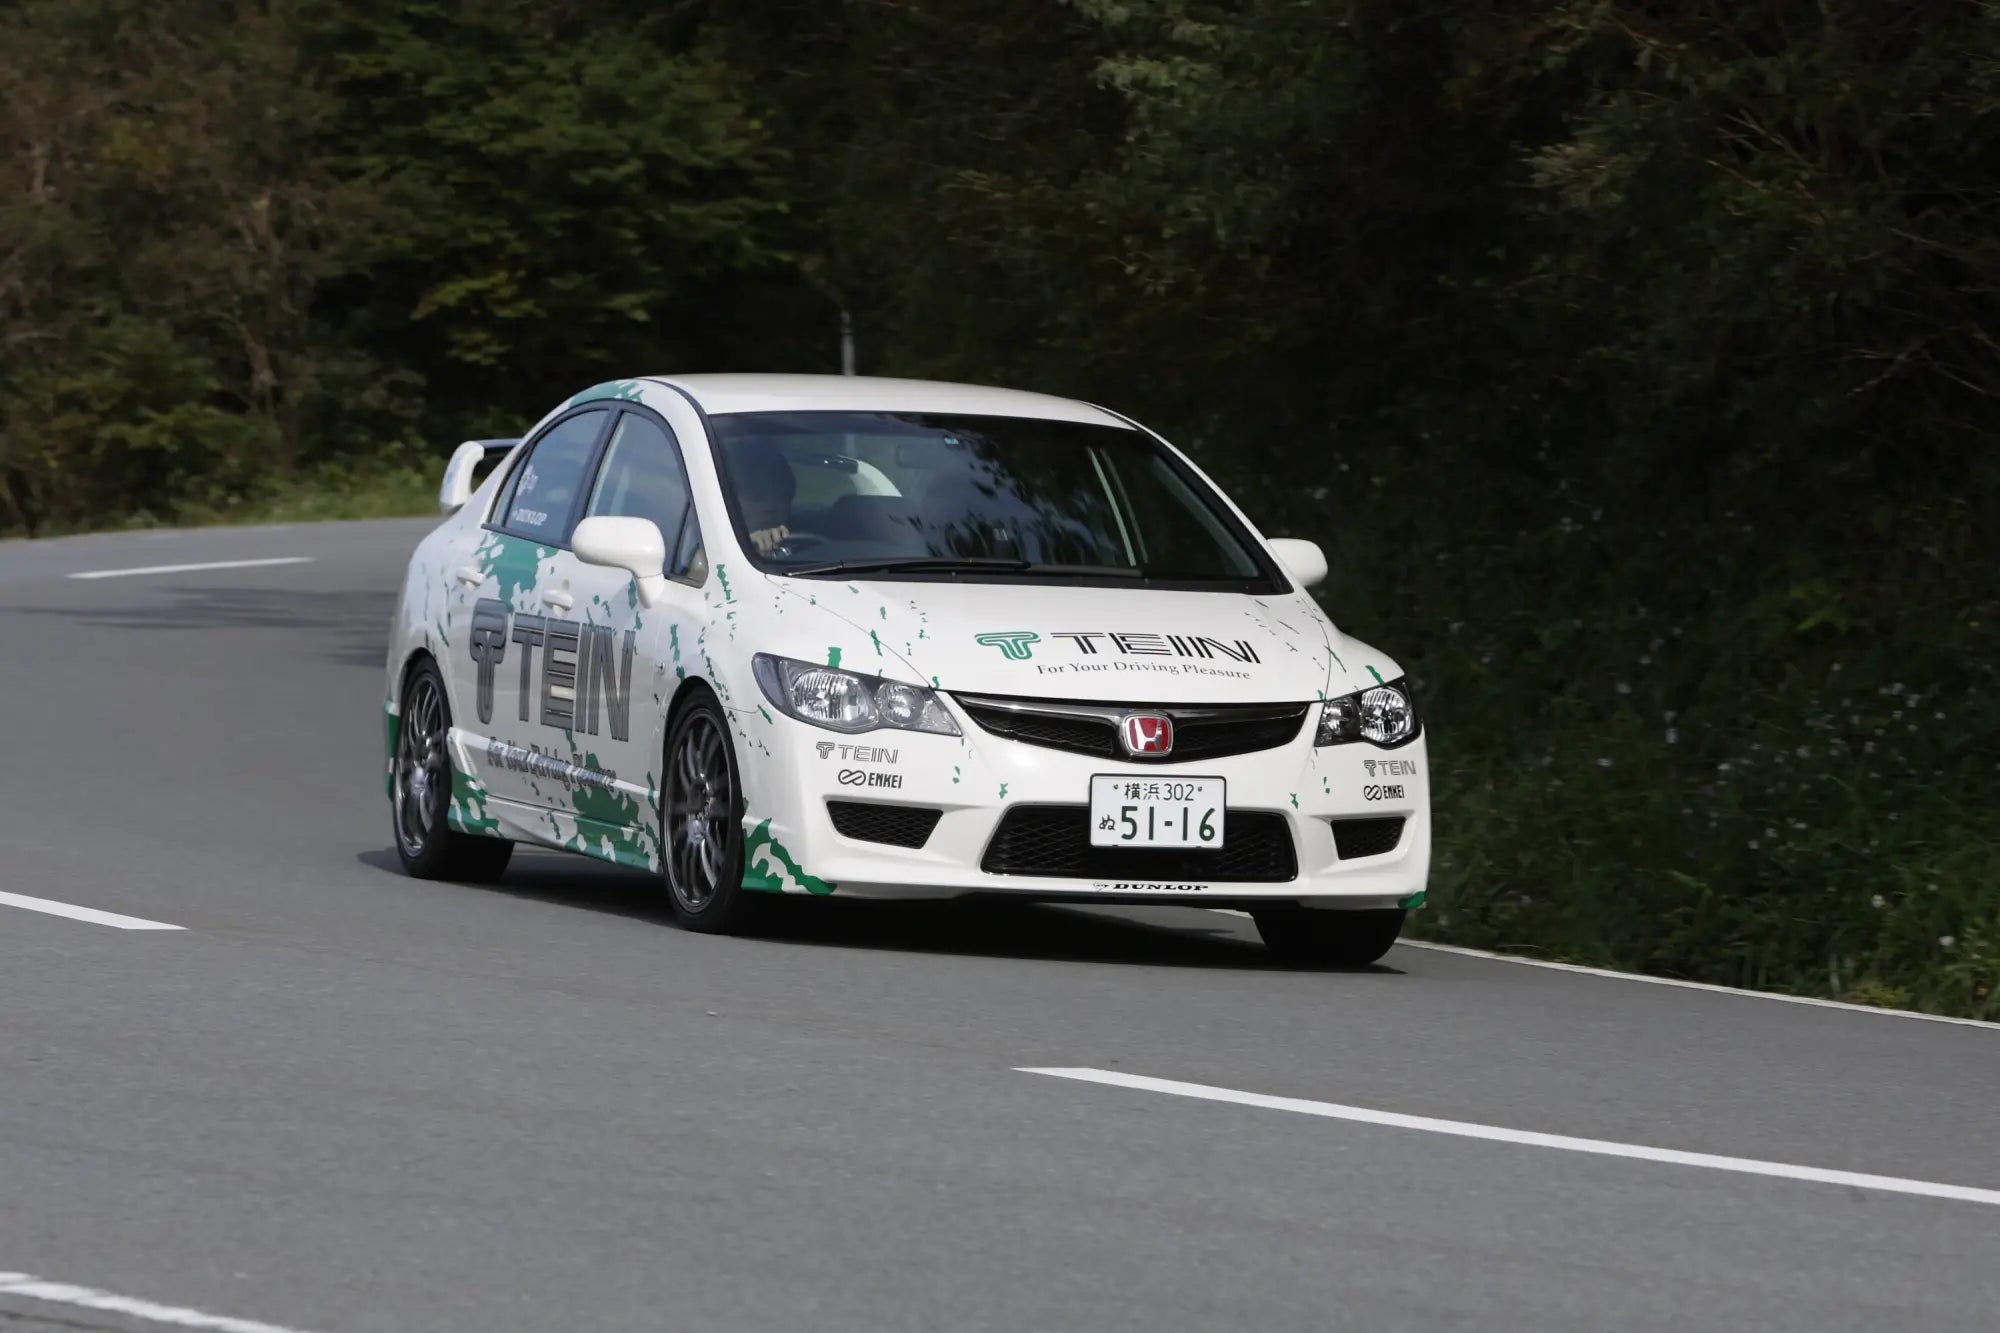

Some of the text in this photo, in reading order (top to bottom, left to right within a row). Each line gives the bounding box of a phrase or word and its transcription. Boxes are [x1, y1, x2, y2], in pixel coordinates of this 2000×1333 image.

[1050, 632, 1261, 664] TEIN
[512, 613, 636, 742] TEIN
[1037, 661, 1251, 680] For Your Driving Pleasure
[837, 744, 899, 764] TEIN
[1377, 760, 1417, 776] TEIN
[868, 772, 902, 789] ENKEI
[1121, 805, 1216, 842] 51-16
[1112, 883, 1208, 891] DUNLOP
